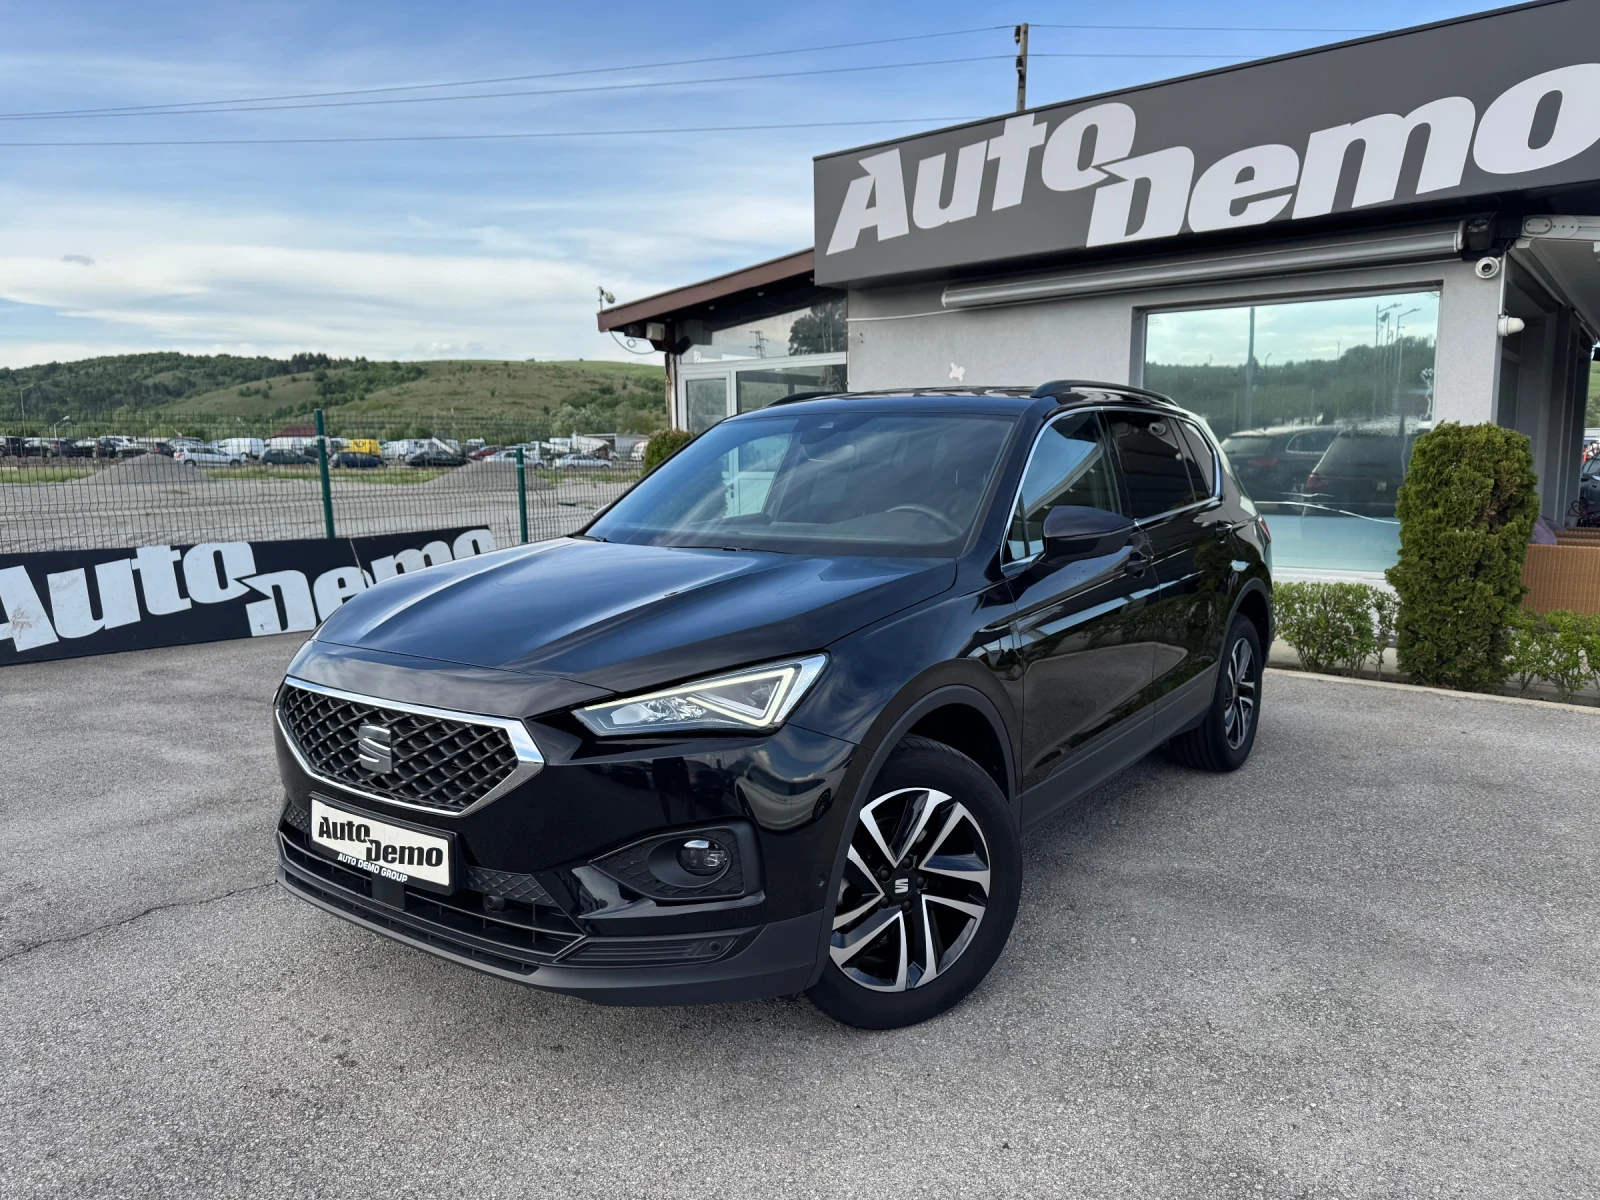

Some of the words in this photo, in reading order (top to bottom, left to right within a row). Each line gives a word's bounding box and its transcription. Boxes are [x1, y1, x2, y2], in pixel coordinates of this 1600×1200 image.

[826, 102, 1137, 256] Auto
[1086, 63, 1600, 248] Demo
[0, 541, 257, 652] Auto
[318, 816, 371, 843] Auto
[366, 838, 444, 867] Demo
[337, 853, 357, 866] AUTO
[357, 860, 380, 874] DEMO
[380, 868, 408, 883] GROUP
